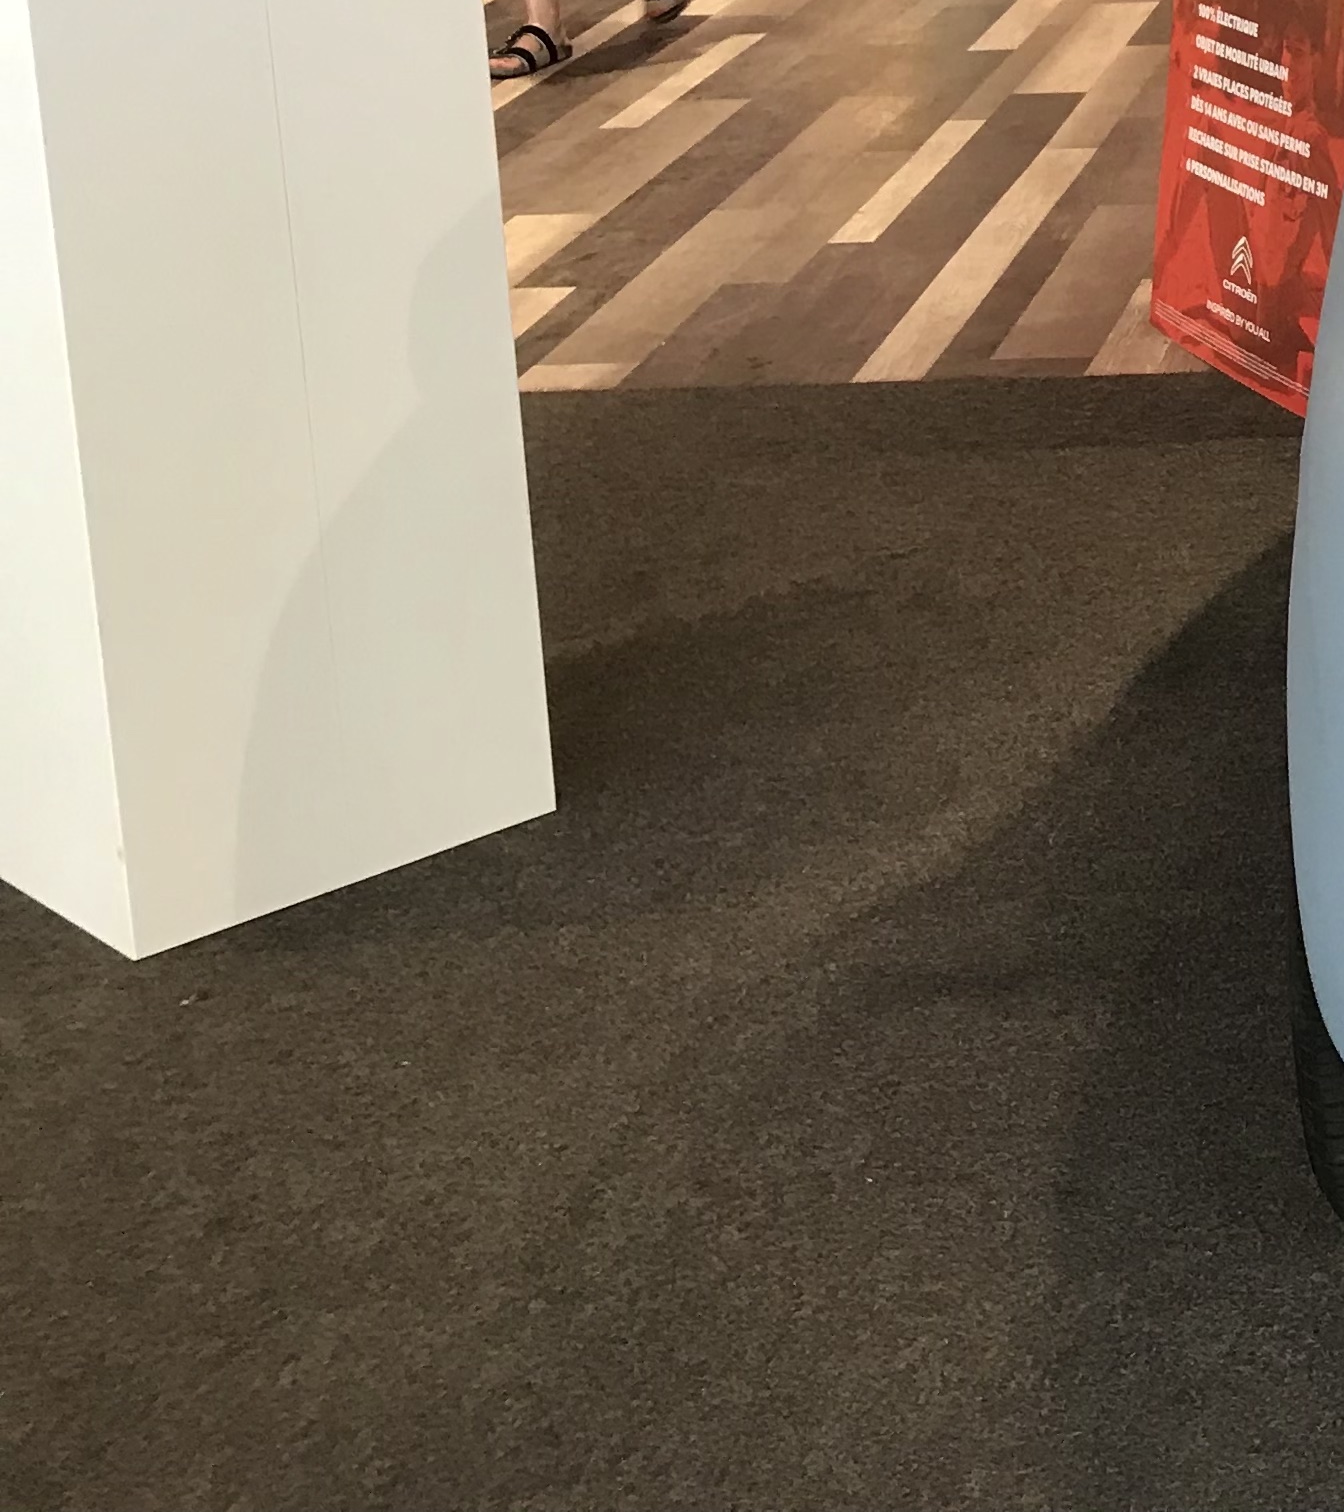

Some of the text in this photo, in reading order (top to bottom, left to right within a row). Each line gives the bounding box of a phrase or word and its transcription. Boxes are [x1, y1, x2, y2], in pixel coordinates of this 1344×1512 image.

[1198, 3, 1259, 38] 100% ÉLECTRIQUE
[1195, 34, 1289, 82] OBJET DE MOBILITÉ URBAIN
[1222, 76, 1249, 100] PLACES
[1249, 87, 1292, 117] PROTÉGÉES
[1191, 94, 1204, 113] DÈS
[1212, 104, 1228, 123] ANS
[1227, 112, 1247, 132] AVEC
[1246, 120, 1258, 137] OU
[1258, 124, 1280, 145] SANS
[1280, 133, 1311, 158] PERMIS
[1188, 126, 1224, 155] RECHARGE
[1224, 142, 1240, 162] SUR
[1239, 148, 1260, 170] PRISE
[1260, 158, 1302, 188] STANDARD
[1302, 176, 1316, 194] EN
[1191, 159, 1266, 207] PERSONNALISATIONS
